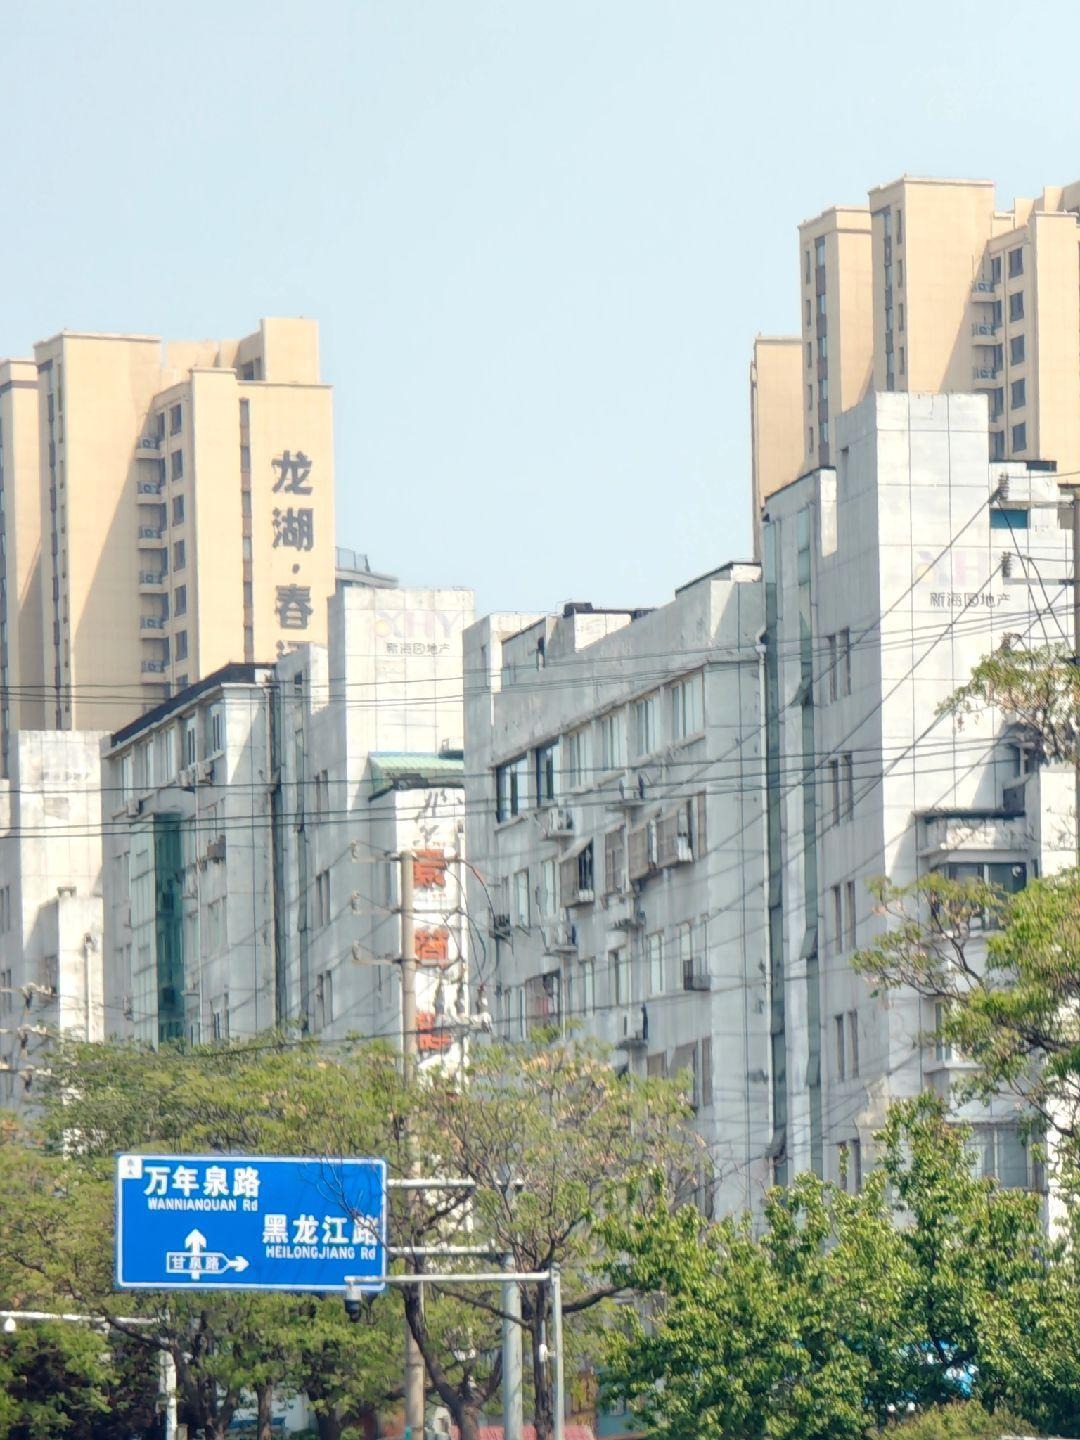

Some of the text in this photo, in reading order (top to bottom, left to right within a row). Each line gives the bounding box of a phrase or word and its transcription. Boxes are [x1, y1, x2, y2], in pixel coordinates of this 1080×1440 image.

[144, 1165, 261, 1198] 万年泉路
[148, 1198, 258, 1212] WANNIANQUAN Rd
[262, 1213, 379, 1246] 黑龙江路
[265, 1245, 376, 1260] HEILONGJIANG Rd
[171, 1255, 220, 1271] 甘泉路
